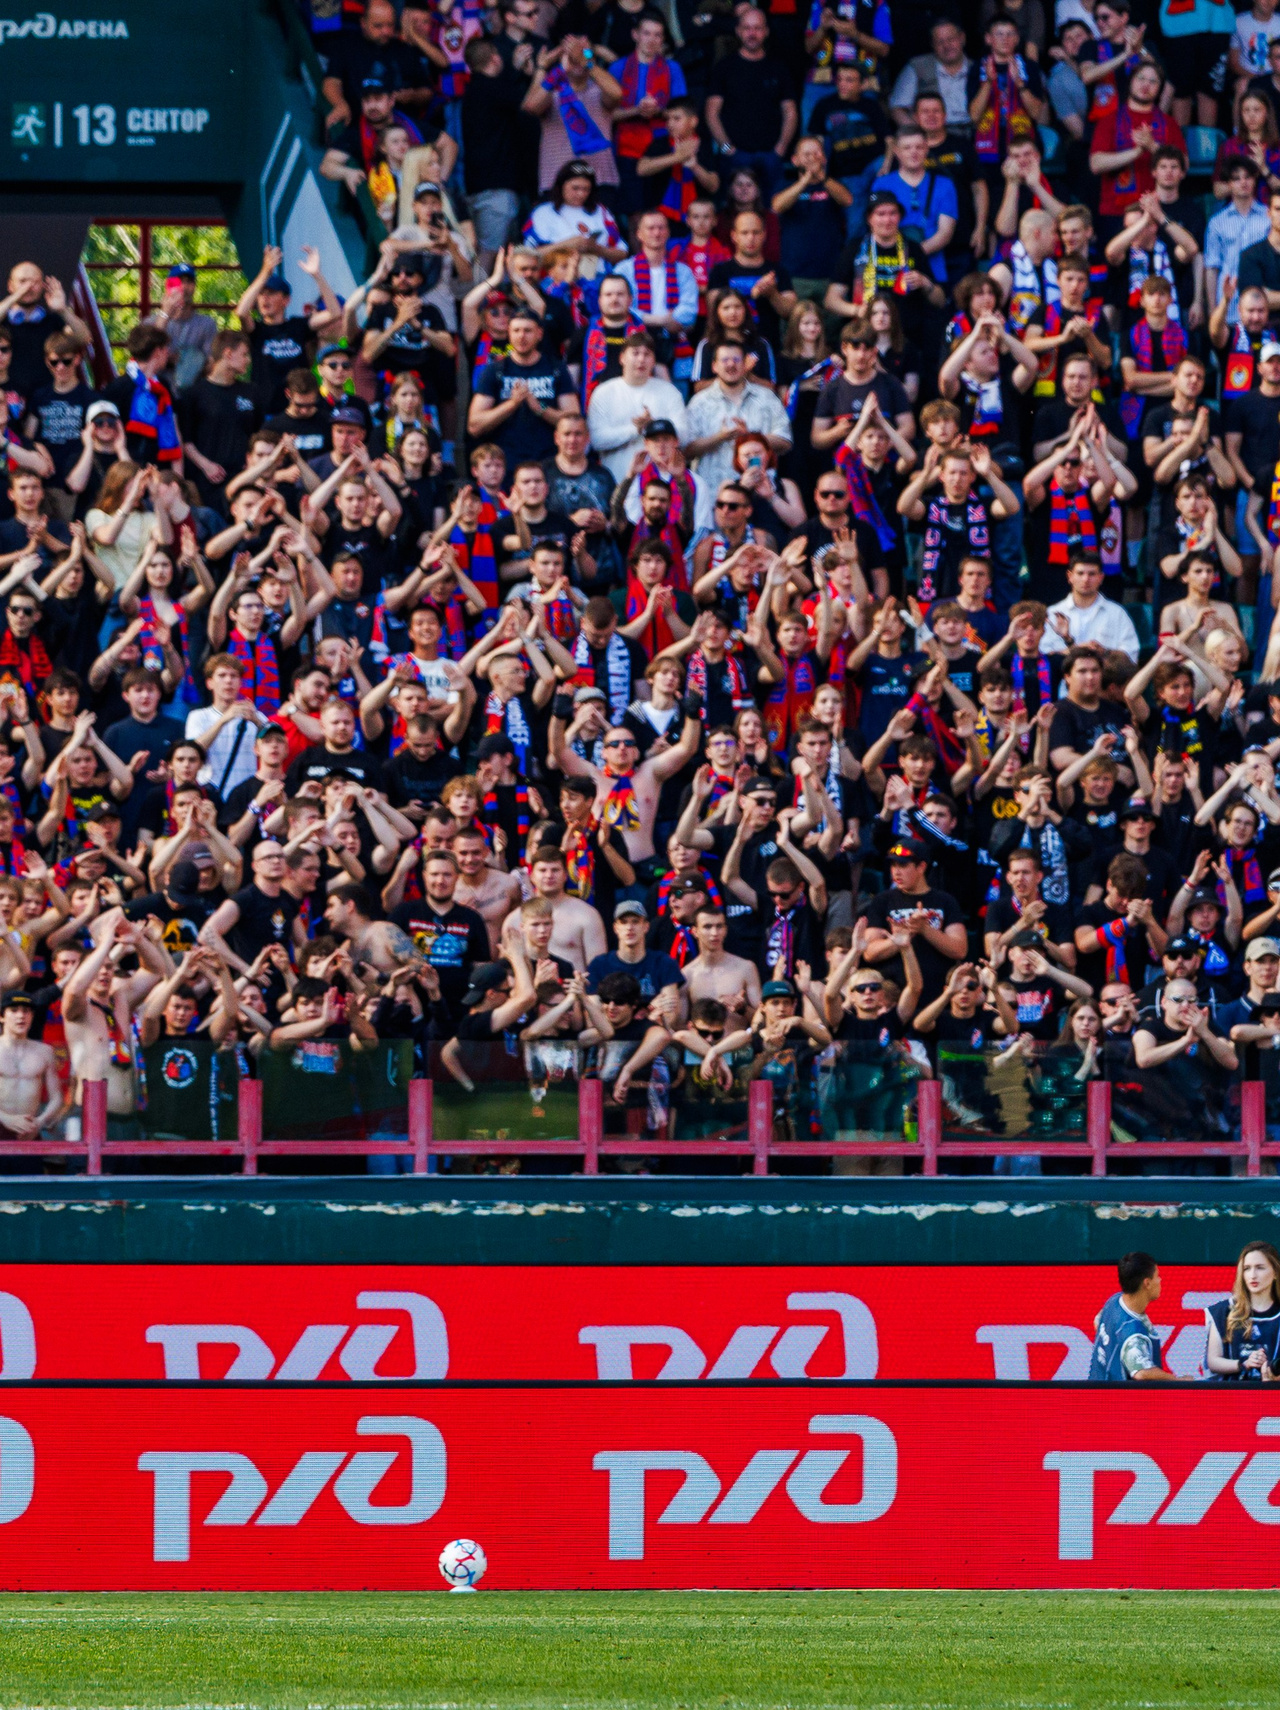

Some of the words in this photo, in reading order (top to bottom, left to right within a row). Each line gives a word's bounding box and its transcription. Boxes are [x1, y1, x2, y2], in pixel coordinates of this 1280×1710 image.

[58, 19, 129, 39] АРЕНА
[73, 104, 117, 145] 13
[126, 108, 210, 132] СЕКТОР
